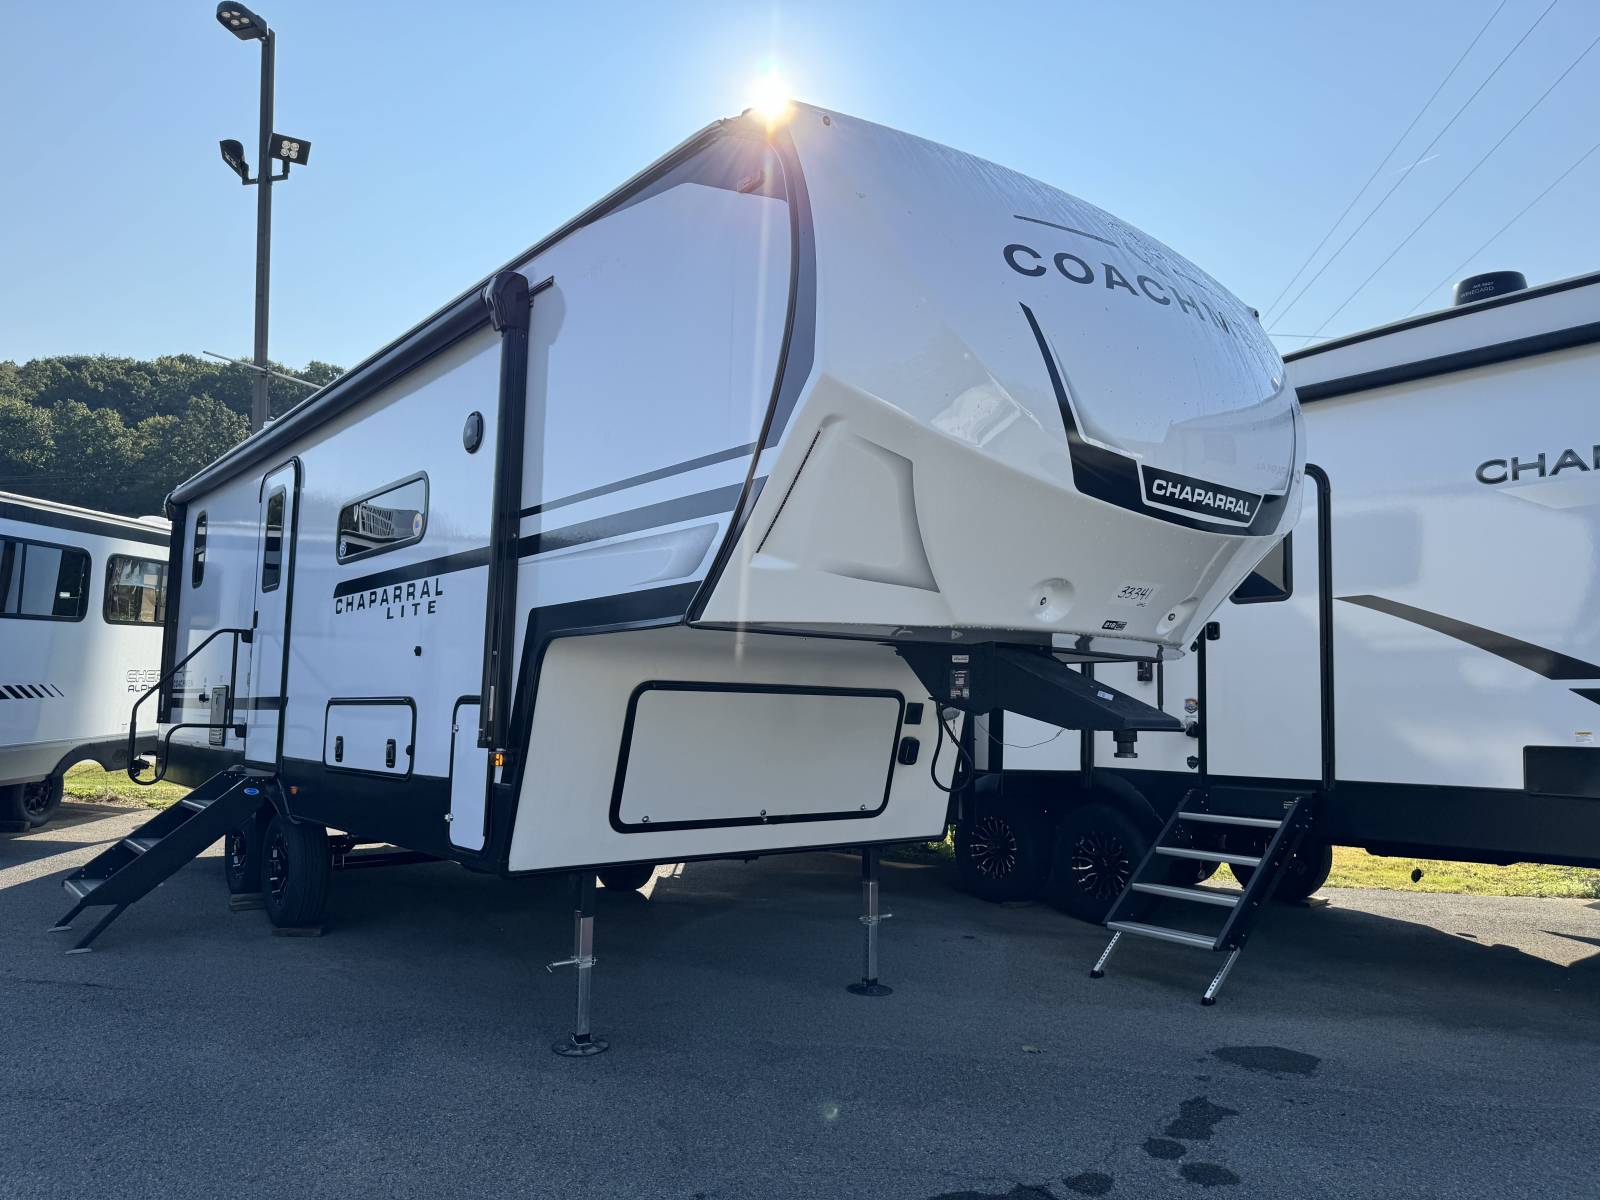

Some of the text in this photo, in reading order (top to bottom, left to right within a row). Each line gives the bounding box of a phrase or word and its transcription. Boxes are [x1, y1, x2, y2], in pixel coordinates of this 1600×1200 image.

[1475, 444, 1600, 485] CHA
[1152, 479, 1251, 516] CHAPARRAL
[335, 577, 444, 615] CHAPARRAL
[386, 600, 437, 620] LITE
[1117, 585, 1153, 600] 33341
